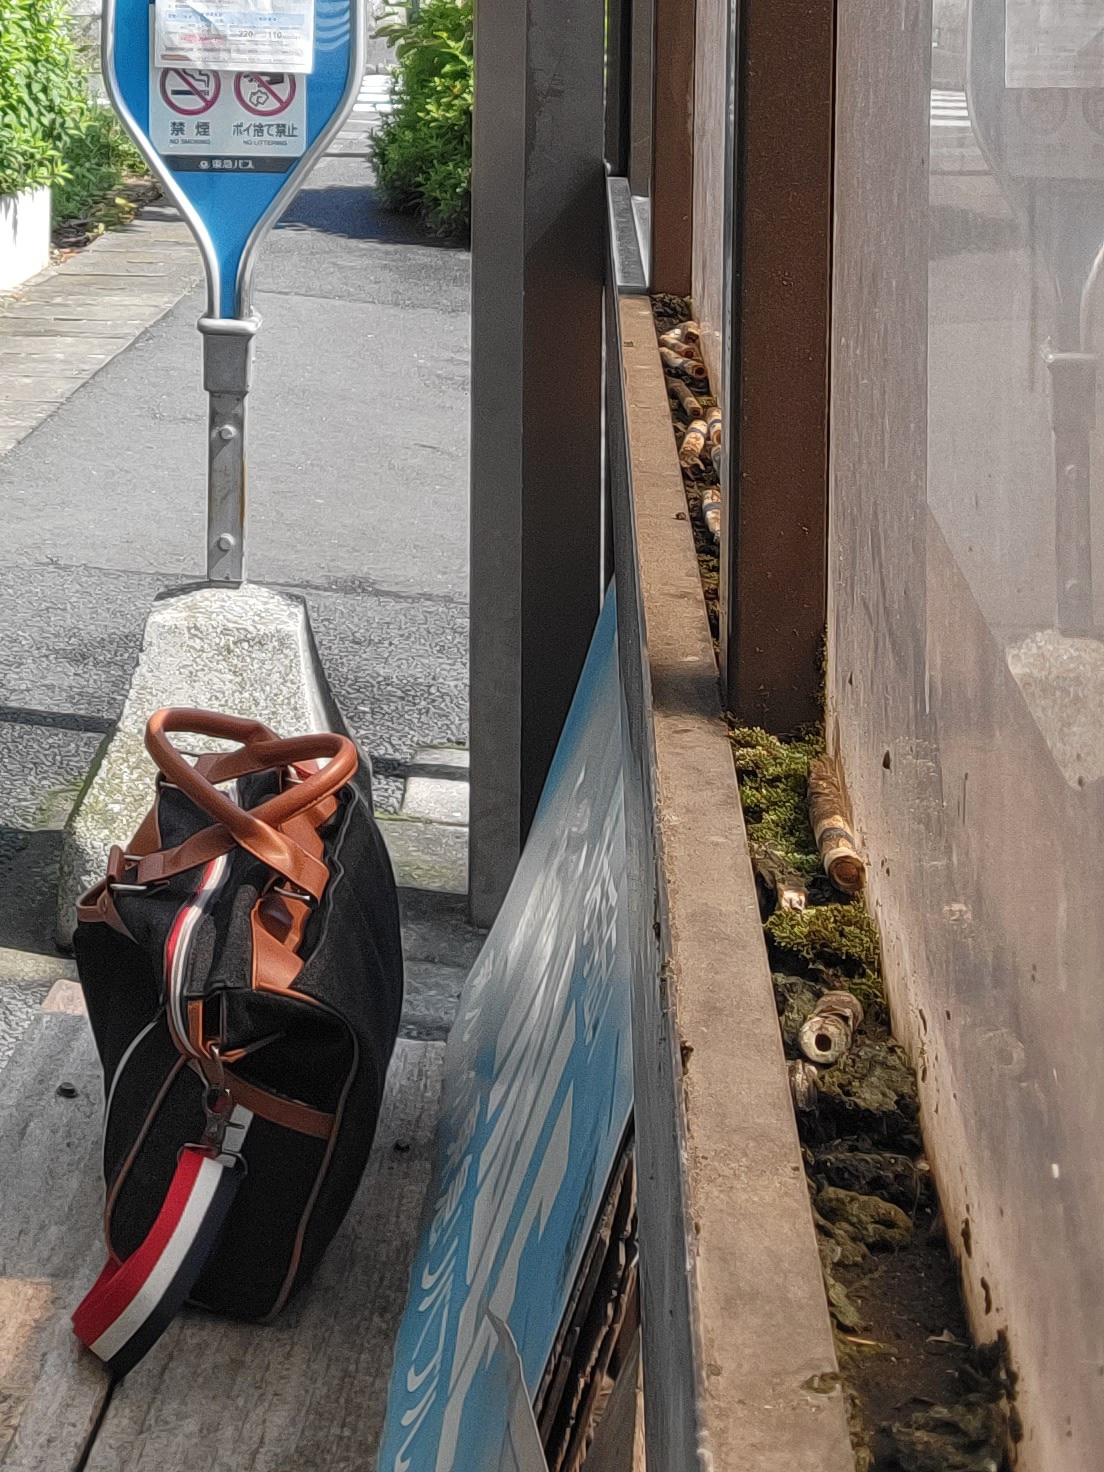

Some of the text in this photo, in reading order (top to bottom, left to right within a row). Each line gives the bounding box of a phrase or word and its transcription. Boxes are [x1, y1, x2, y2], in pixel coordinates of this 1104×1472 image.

[170, 121, 211, 136] 禁煙
[232, 122, 299, 138] ポイ捨て禁止
[211, 159, 254, 169] 東急バス
